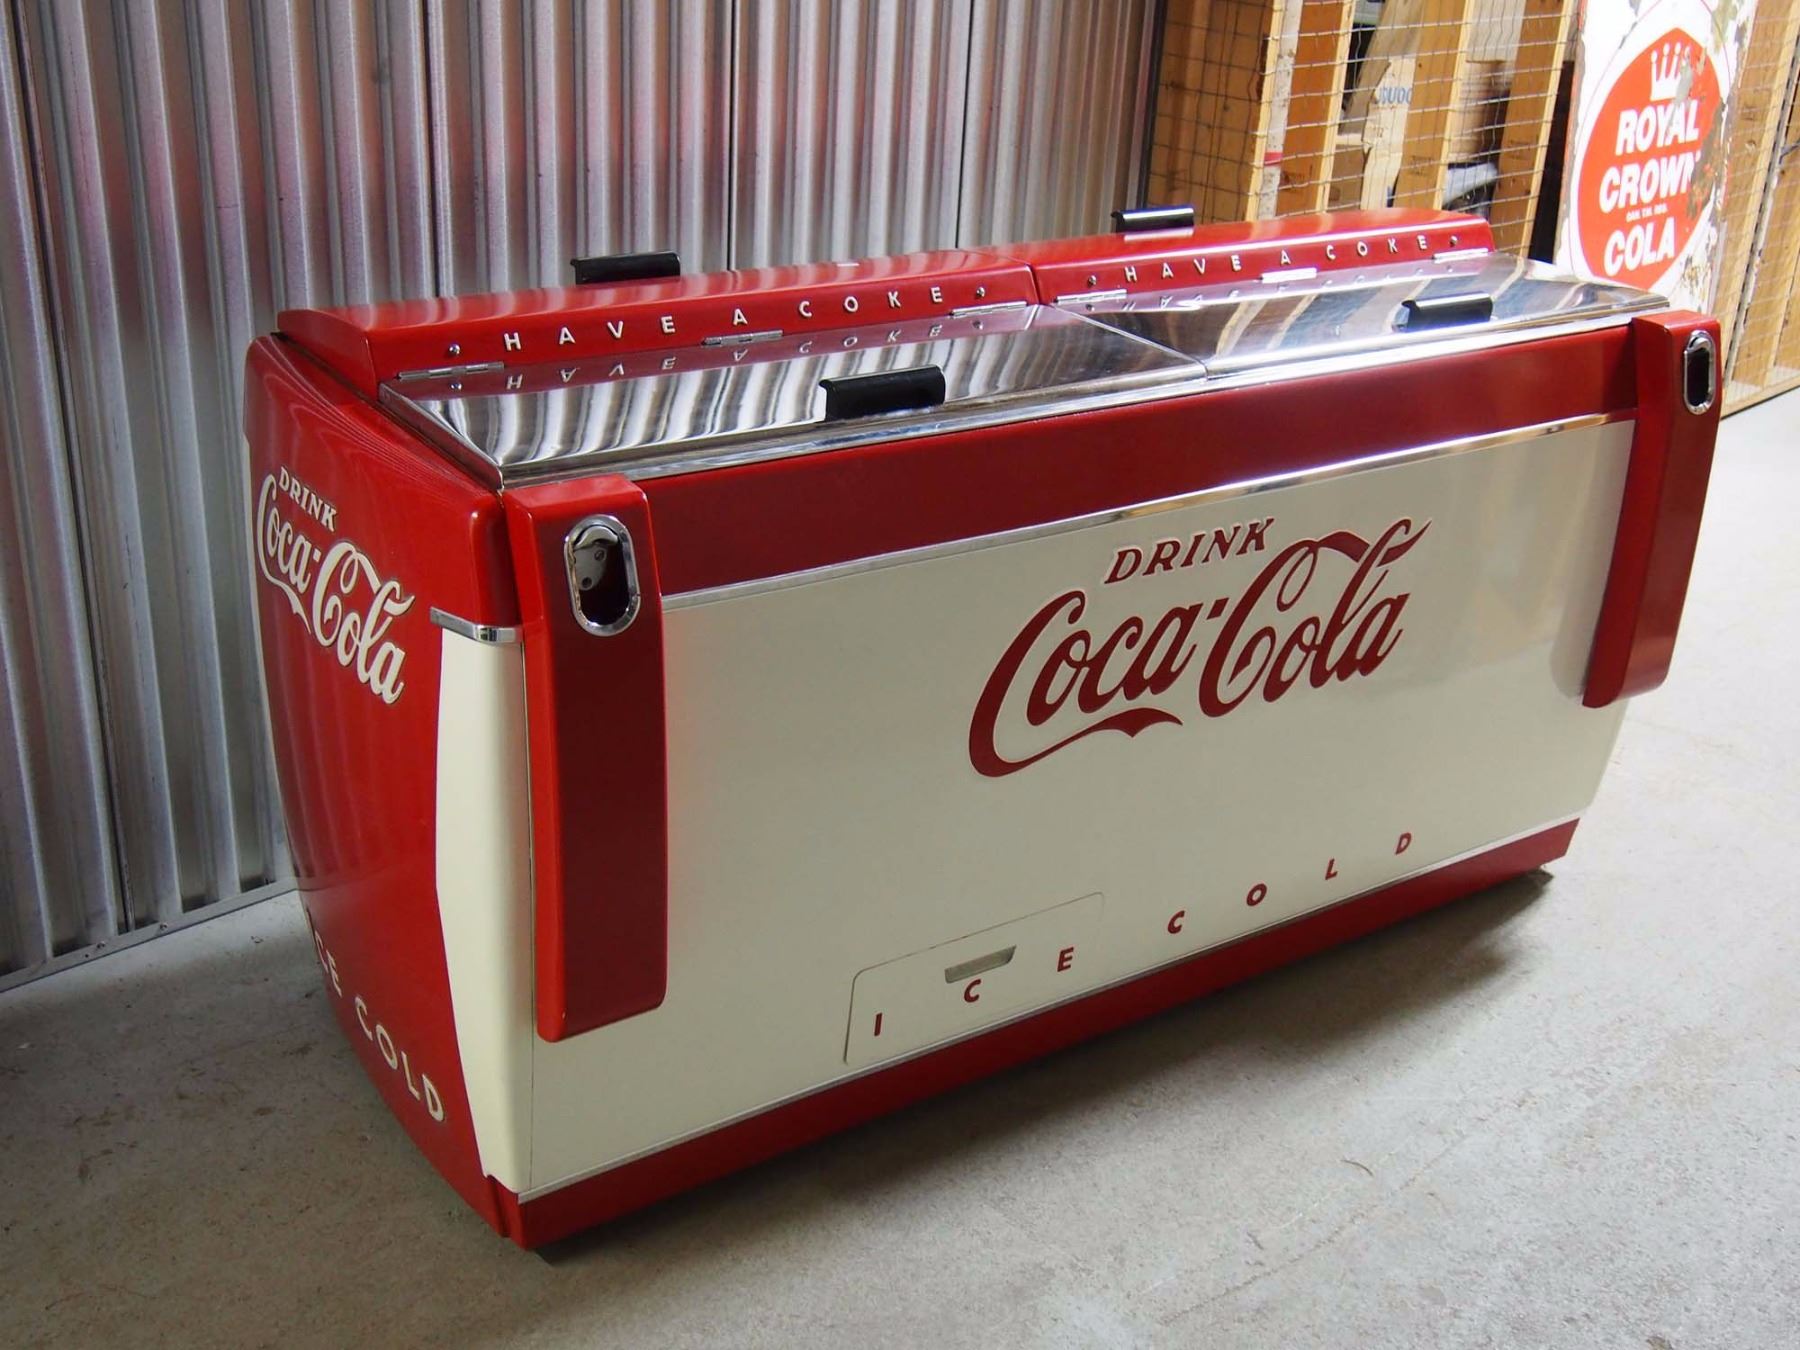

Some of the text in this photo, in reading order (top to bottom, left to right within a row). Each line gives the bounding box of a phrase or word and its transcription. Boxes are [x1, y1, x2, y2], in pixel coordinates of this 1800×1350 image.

[1615, 99, 1699, 156] ROYAL
[1124, 234, 1428, 283] HAVE A COKE
[1603, 216, 1675, 277] COLA
[503, 286, 943, 351] HAVE A COKE
[279, 466, 337, 532] DRINK
[1103, 518, 1275, 584] DRINK
[257, 474, 416, 705] Coca-Cola
[968, 518, 1432, 778] Coca-Cola
[873, 832, 1412, 1037] ICE COLD
[354, 996, 444, 1112] COLD
